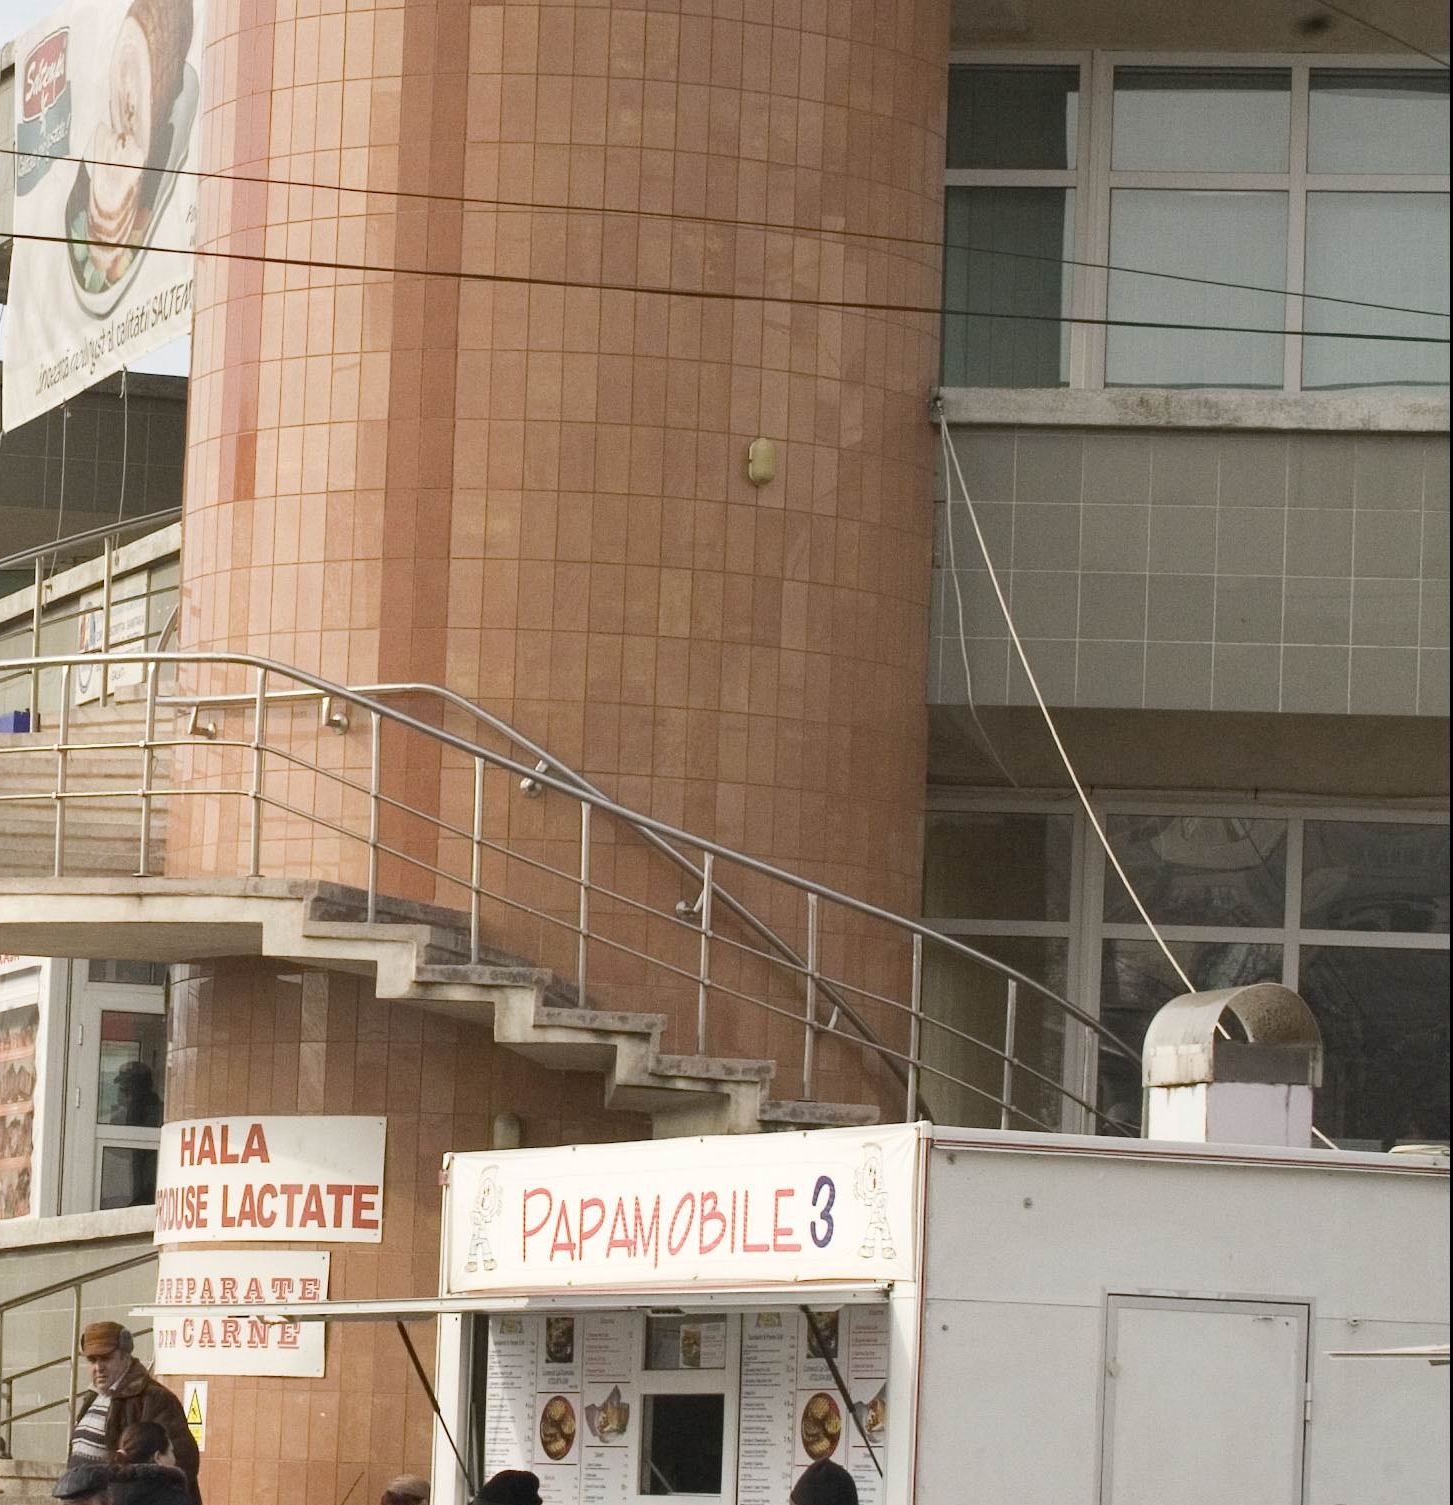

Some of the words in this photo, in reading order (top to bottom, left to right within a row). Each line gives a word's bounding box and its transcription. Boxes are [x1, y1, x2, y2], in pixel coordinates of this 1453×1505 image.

[180, 1123, 270, 1167] HALA
[221, 1183, 379, 1230] LACTATE
[522, 1187, 802, 1269] PAPAMOBILE
[810, 1175, 836, 1248] 3
[158, 1277, 320, 1304] PREPARATE
[182, 1317, 301, 1350] CARNE
